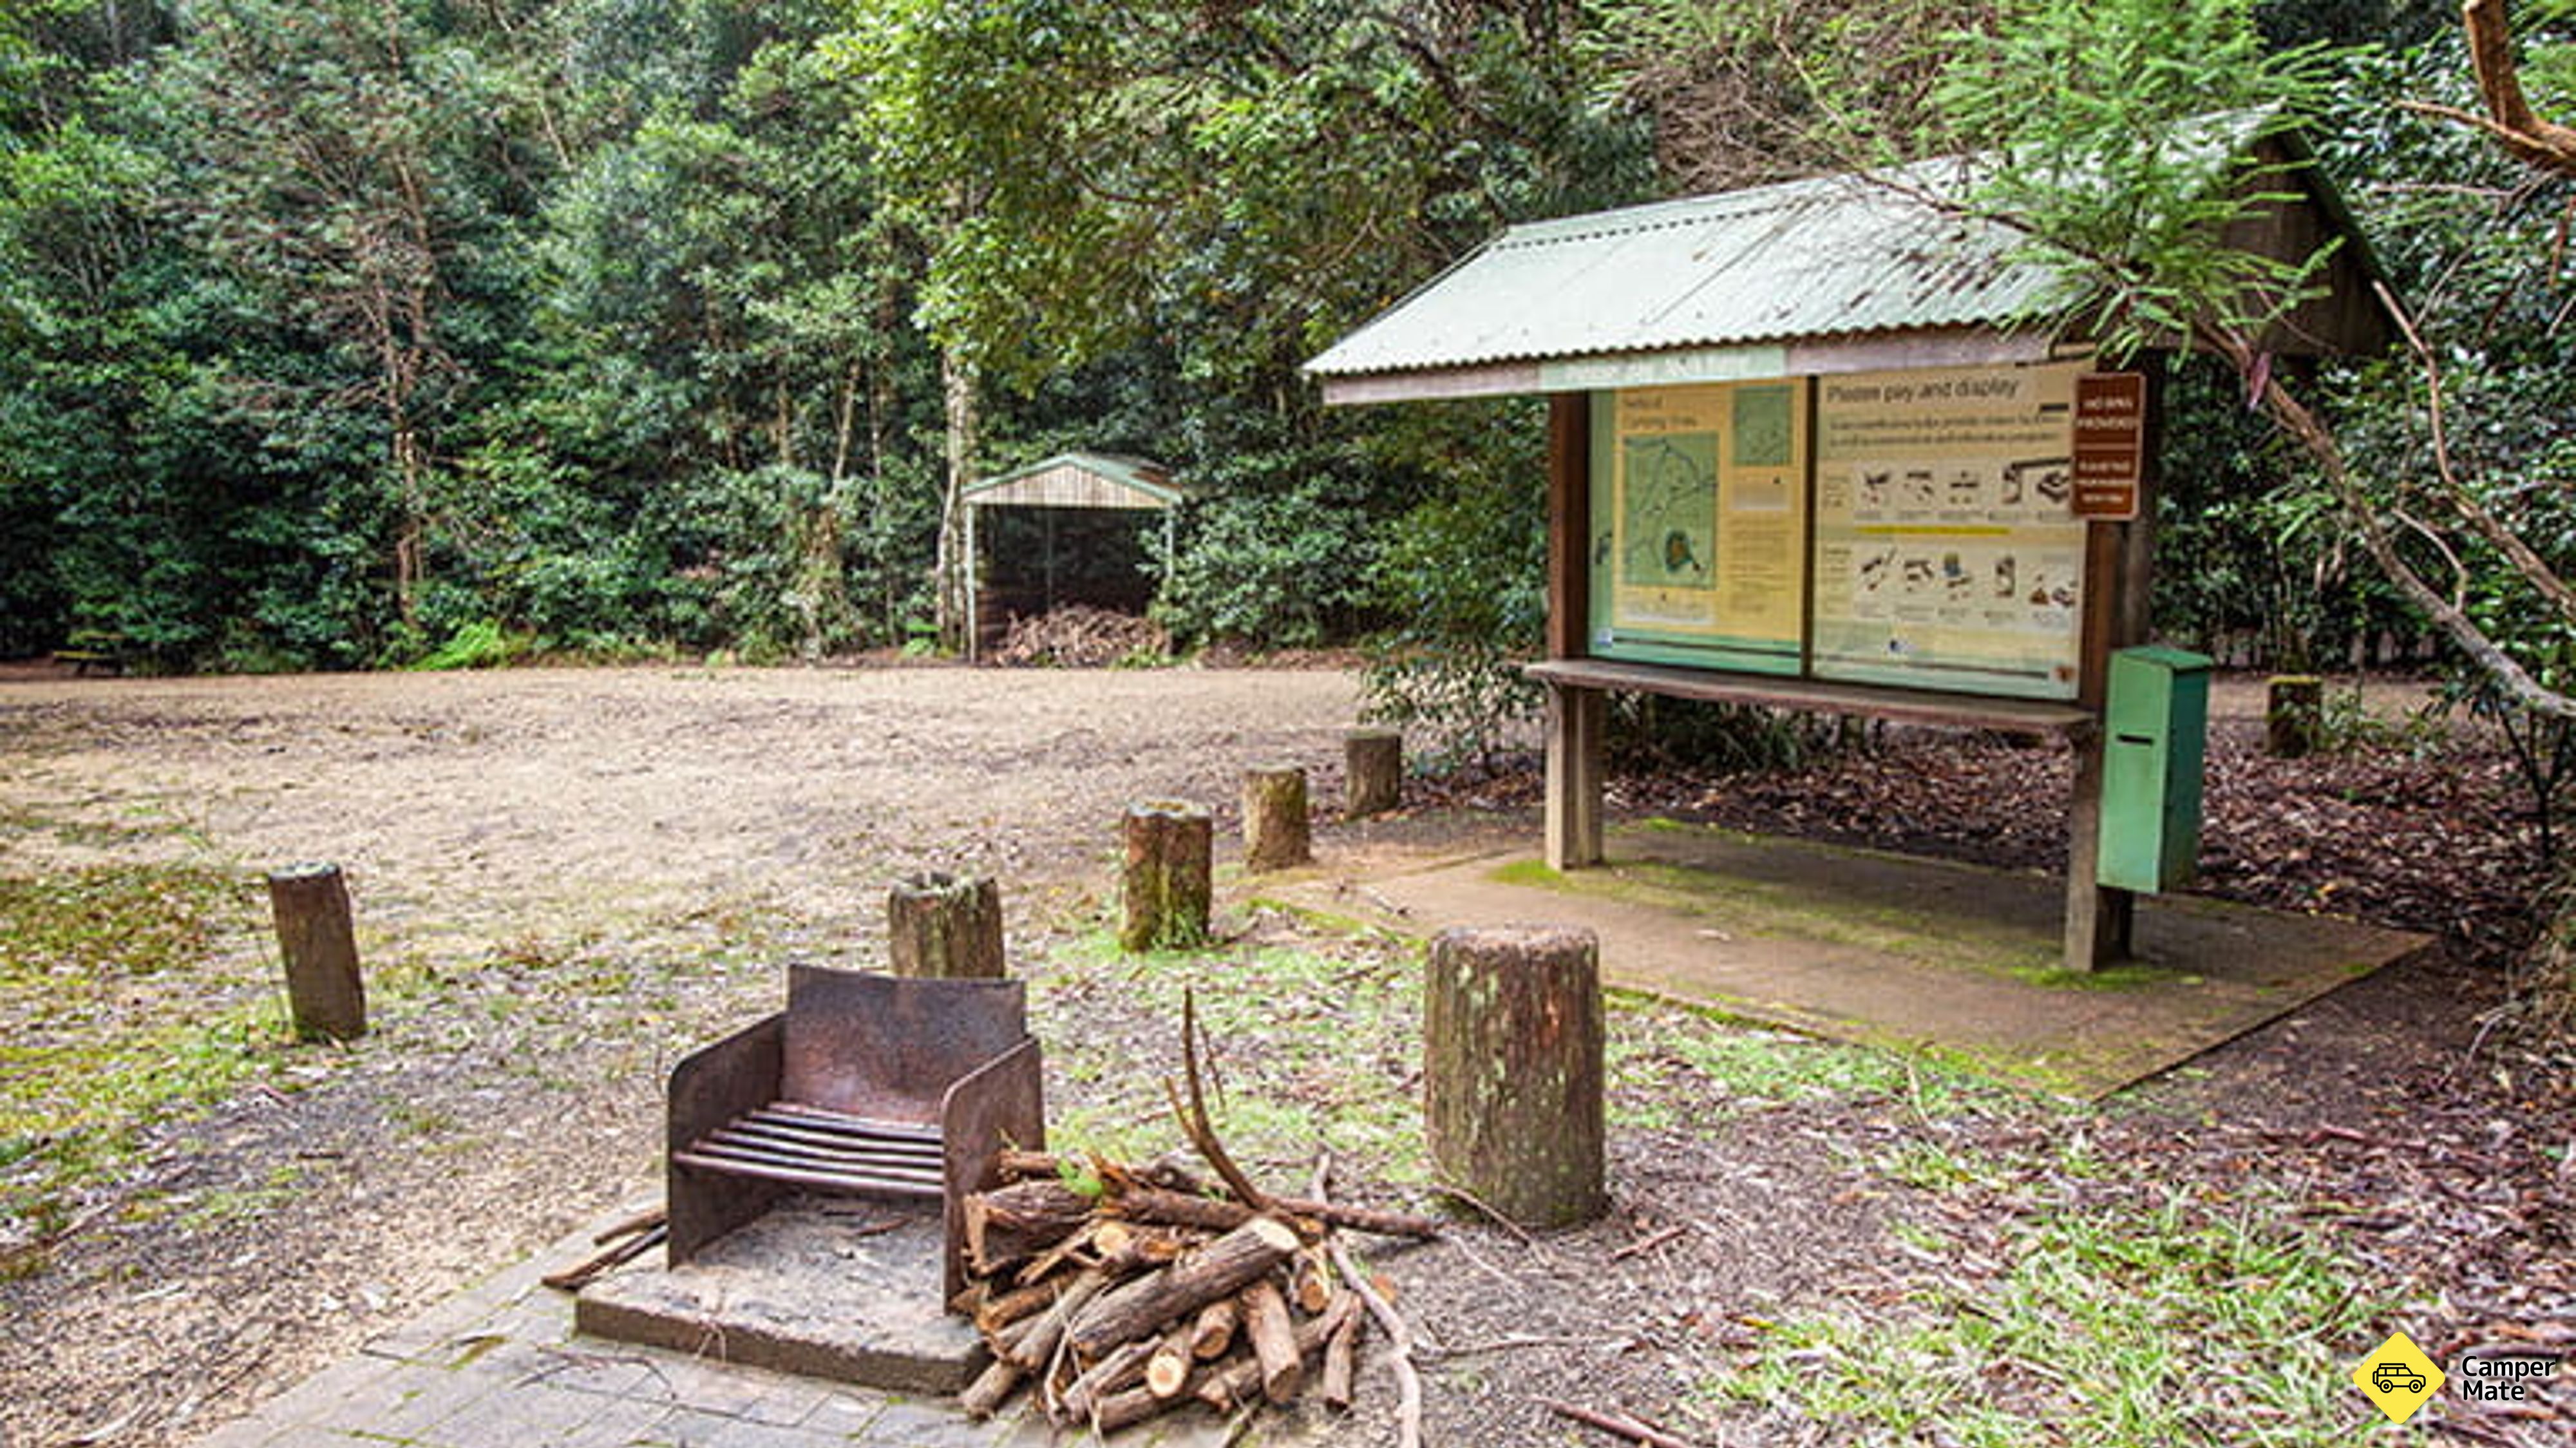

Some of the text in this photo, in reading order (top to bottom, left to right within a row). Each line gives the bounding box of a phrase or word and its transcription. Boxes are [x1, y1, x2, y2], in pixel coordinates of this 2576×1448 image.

[1884, 384, 1914, 403] pay
[1918, 381, 1951, 398] and
[1955, 376, 2020, 399] display
